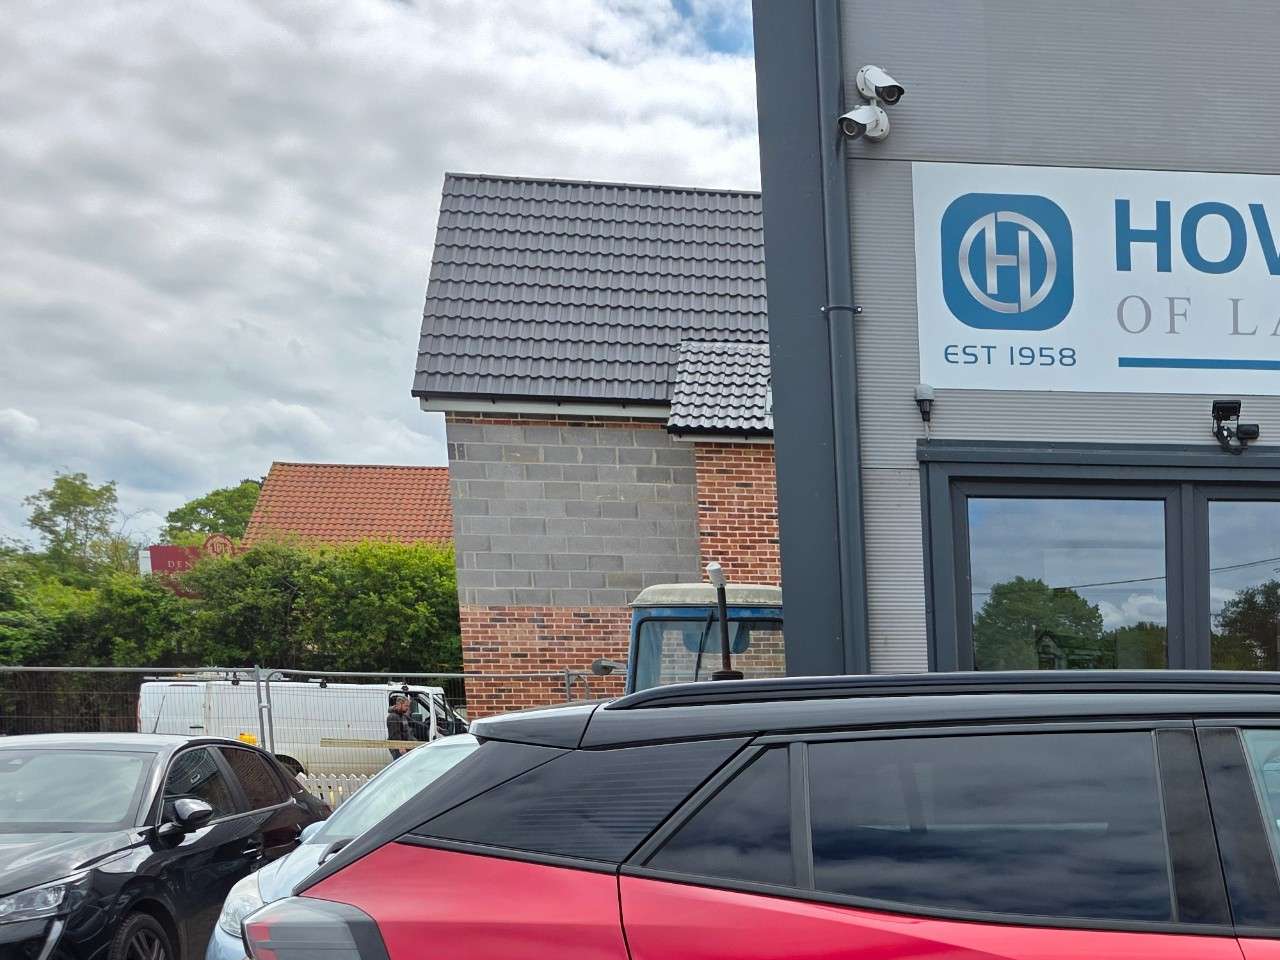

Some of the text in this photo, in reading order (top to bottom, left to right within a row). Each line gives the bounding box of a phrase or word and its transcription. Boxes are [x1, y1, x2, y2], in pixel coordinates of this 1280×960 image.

[1117, 295, 1191, 335] OF
[944, 345, 1077, 367] EST 1958
